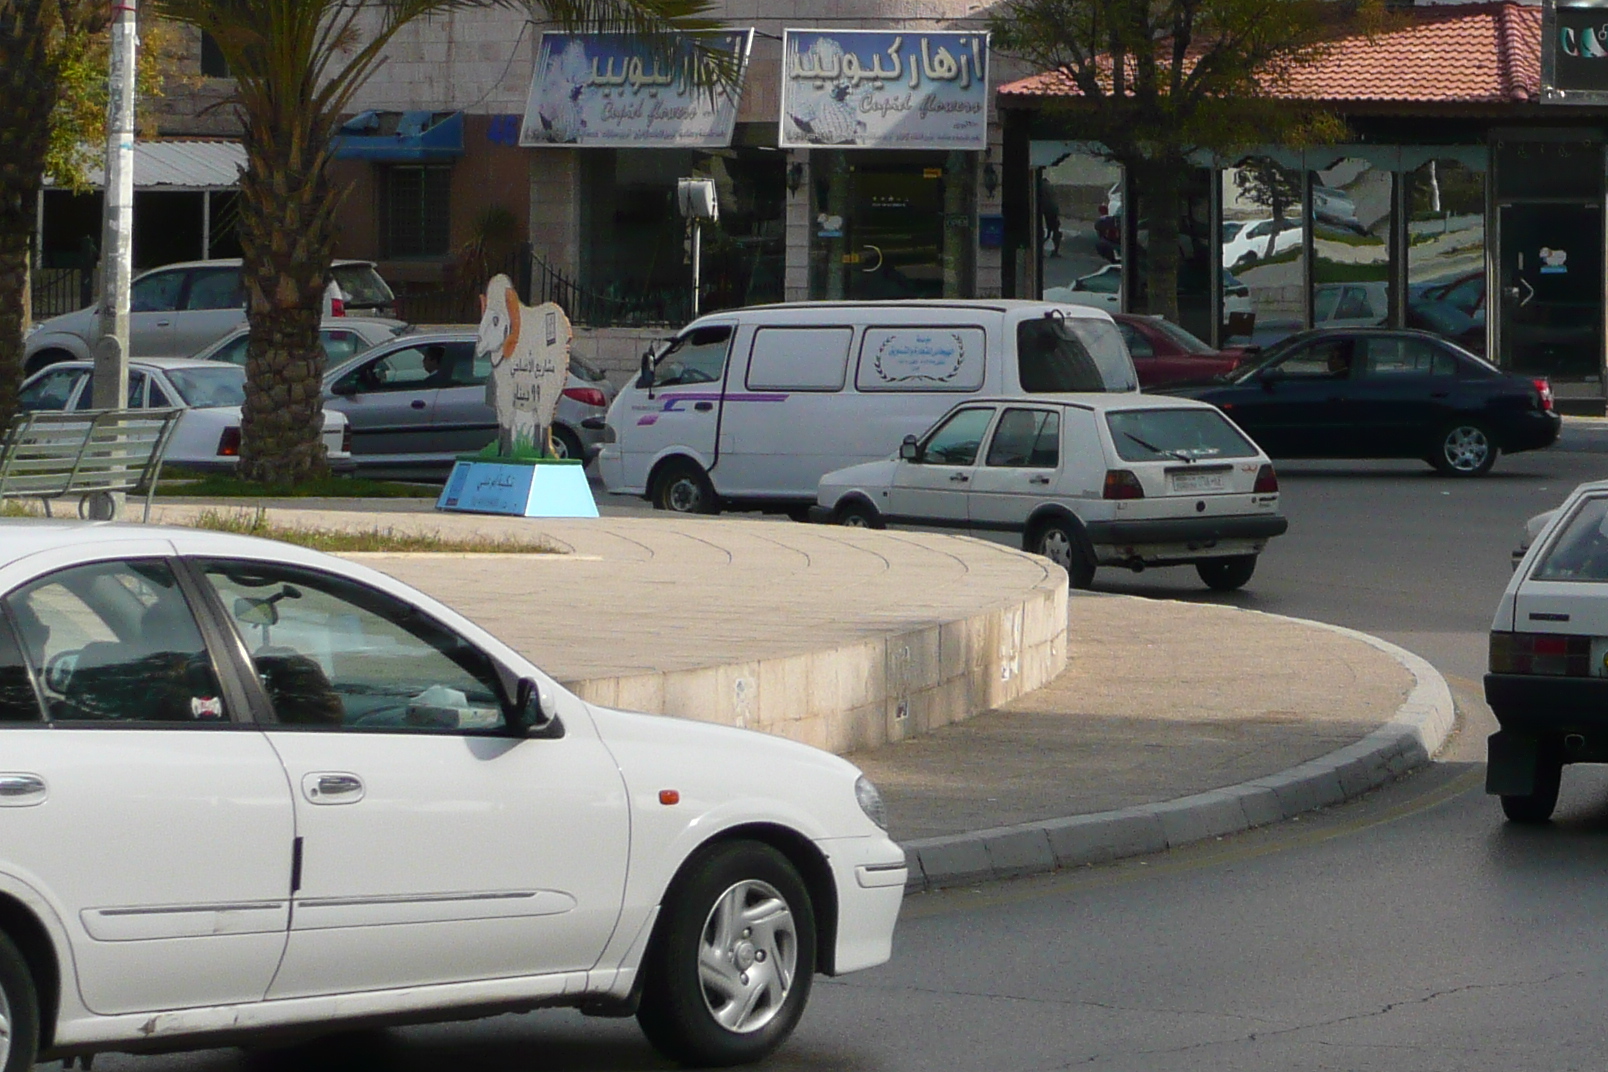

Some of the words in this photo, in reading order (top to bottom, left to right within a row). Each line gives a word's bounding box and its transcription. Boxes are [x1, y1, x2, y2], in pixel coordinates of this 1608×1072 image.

[788, 36, 903, 90] كيوبيد
[908, 37, 983, 90] ازهار
[601, 99, 646, 126] Cupid
[859, 92, 913, 118] Cupid
[919, 92, 982, 120] flowers
